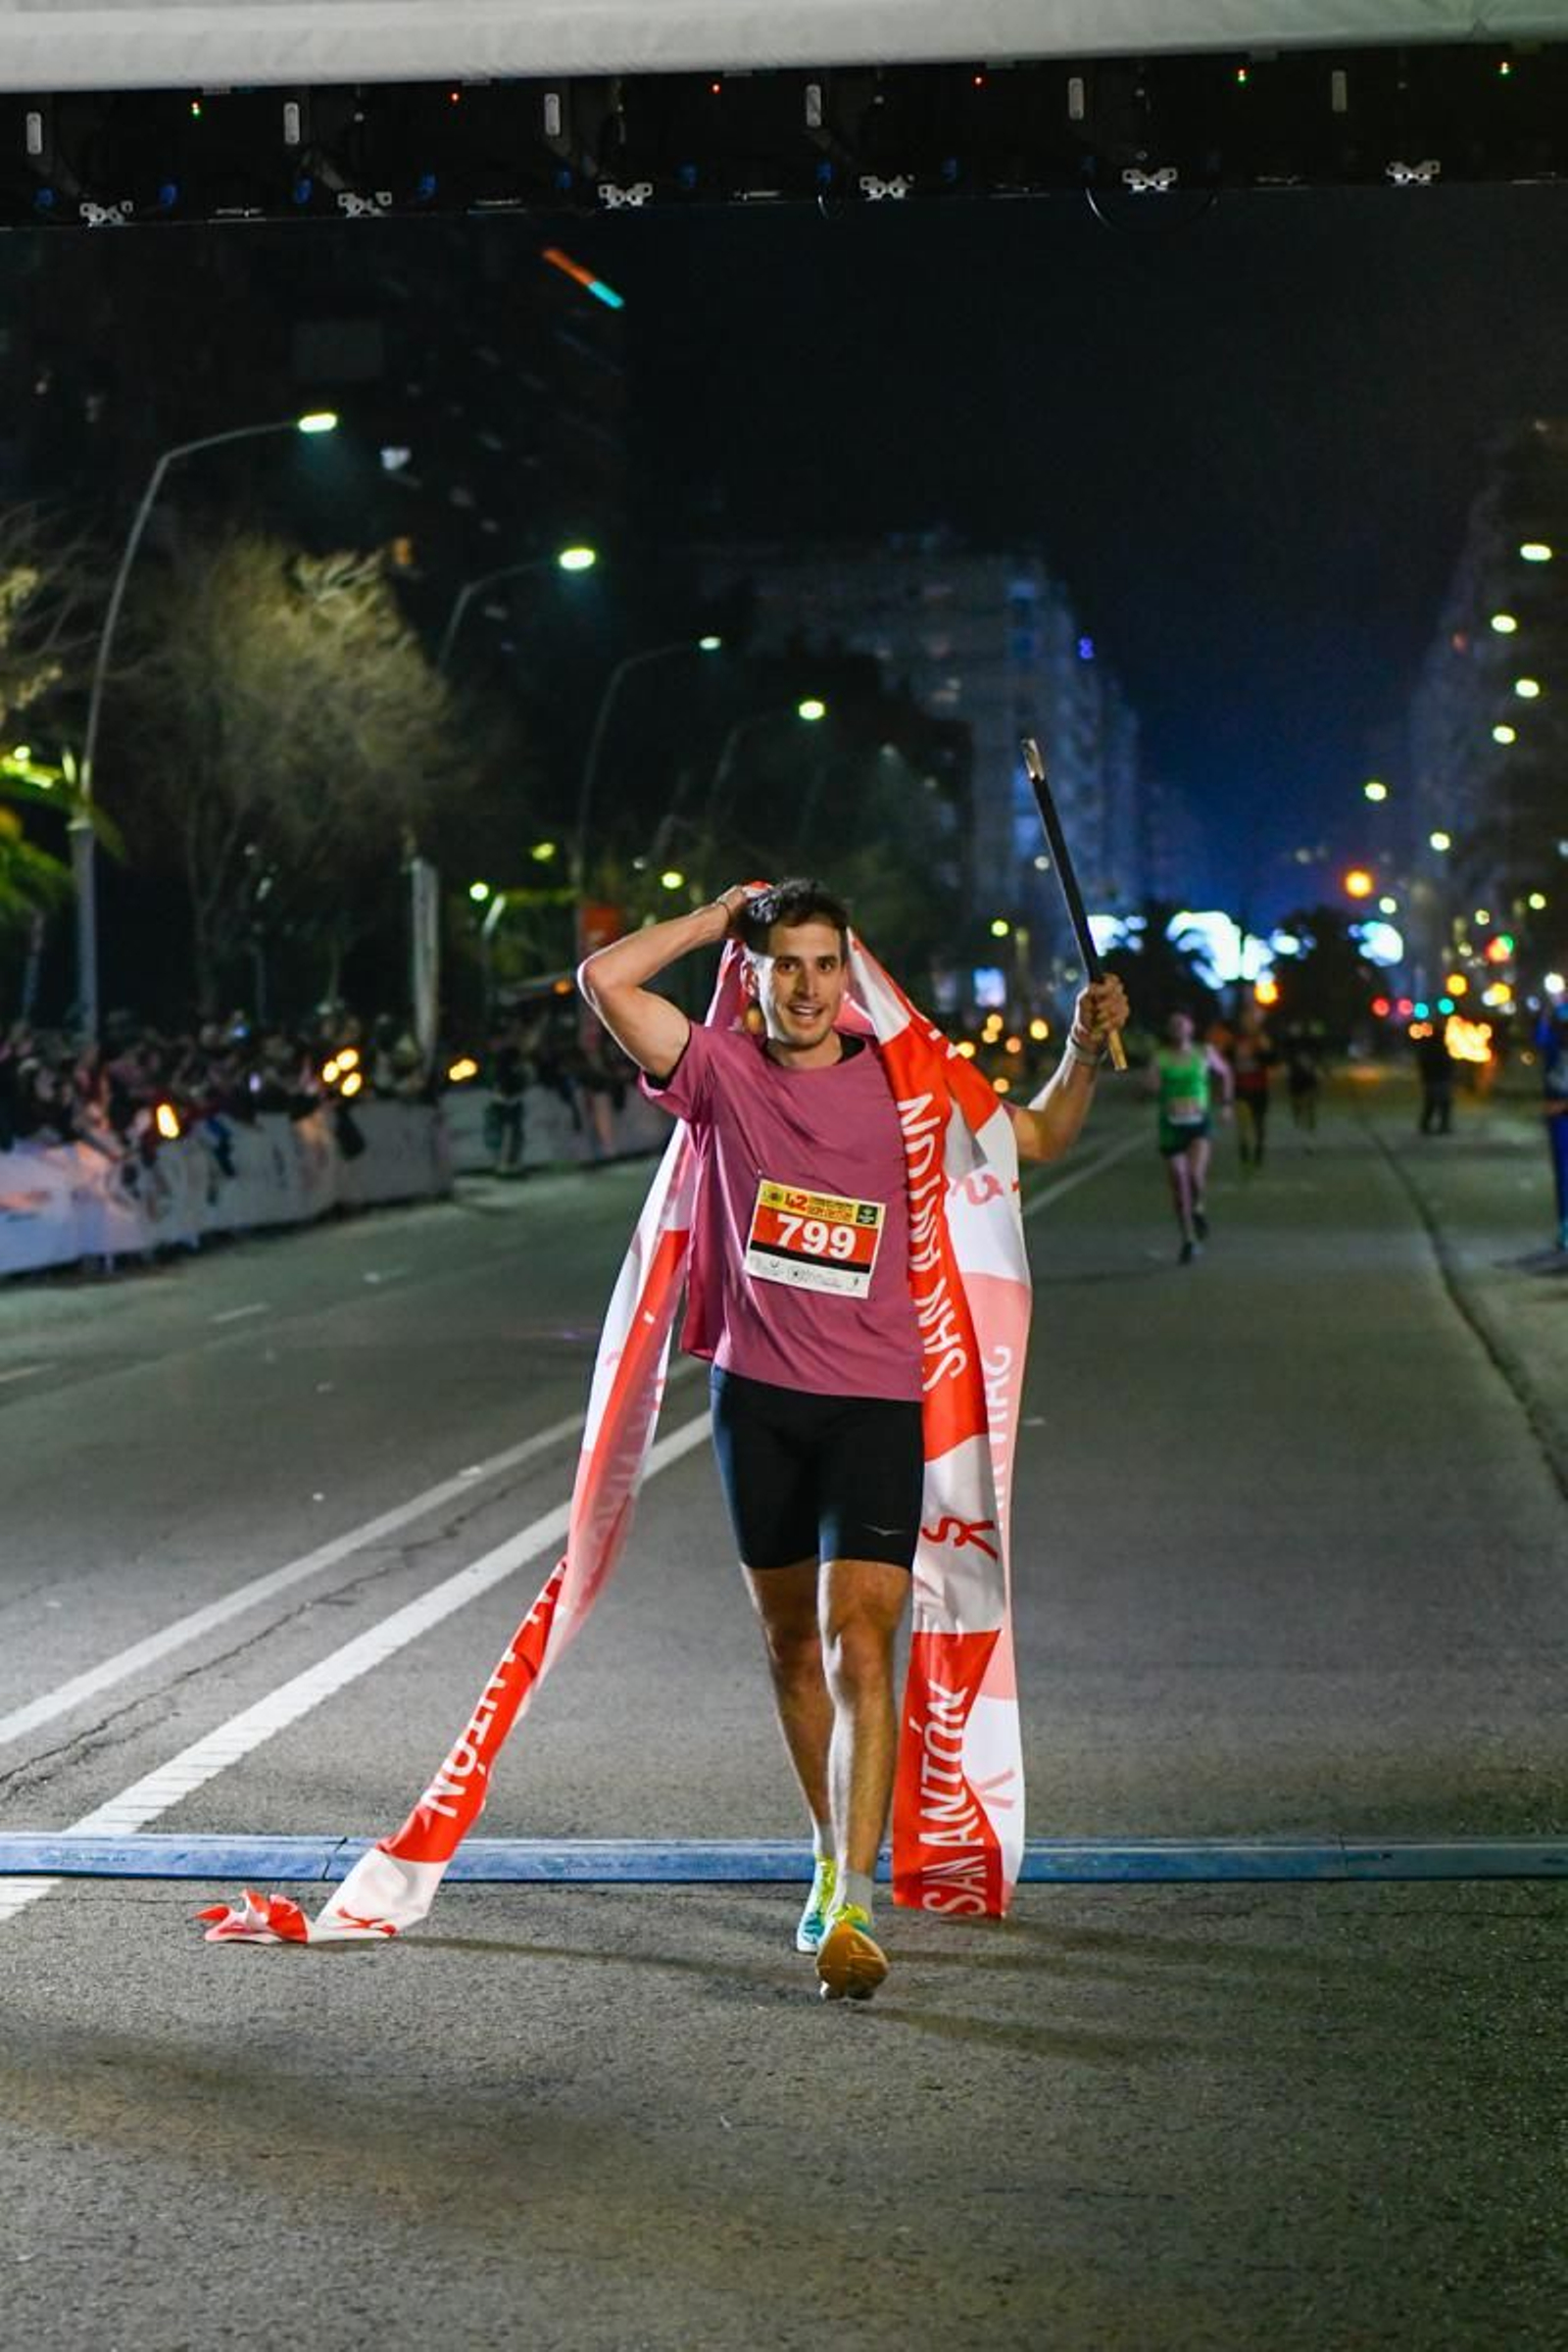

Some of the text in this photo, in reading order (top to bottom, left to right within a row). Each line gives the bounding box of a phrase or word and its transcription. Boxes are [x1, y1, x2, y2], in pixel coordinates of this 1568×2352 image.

[777, 1212, 857, 1259] 799
[914, 1276, 967, 1392] SAN
[908, 1678, 988, 1918] SAN ANTÓN
